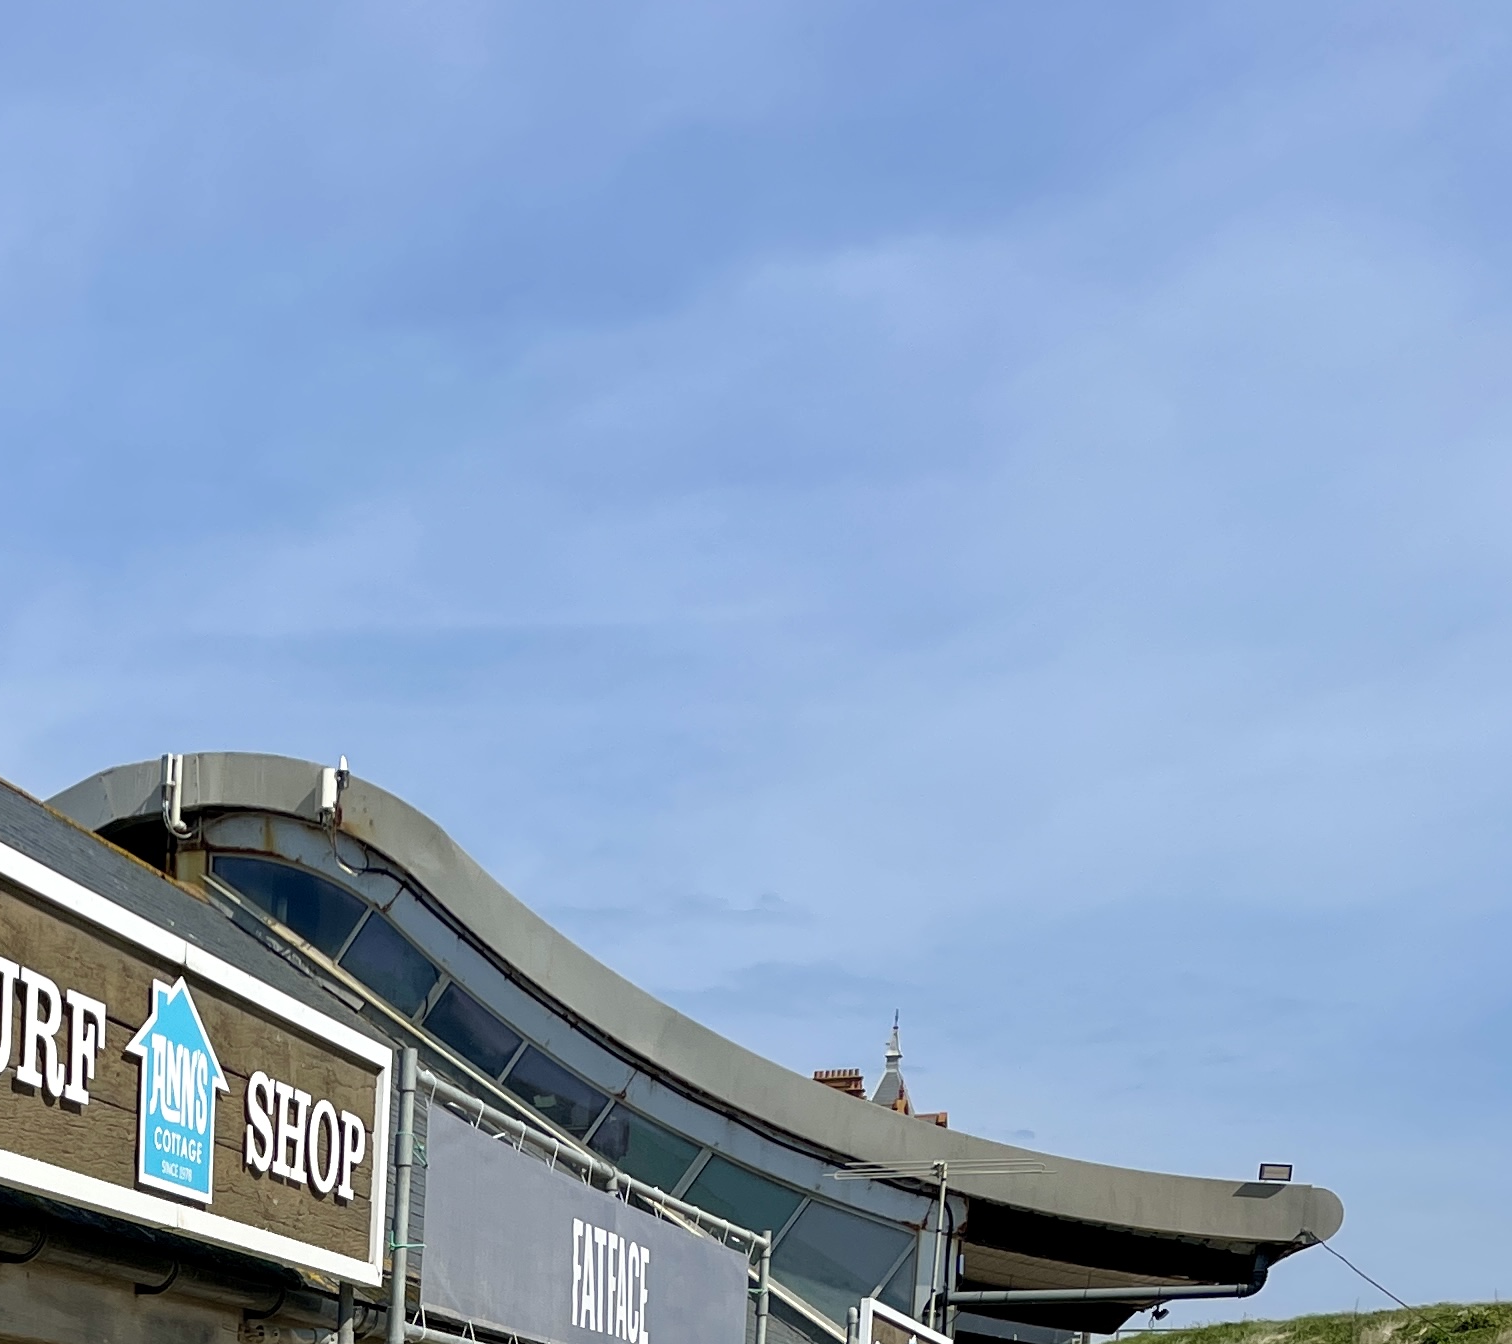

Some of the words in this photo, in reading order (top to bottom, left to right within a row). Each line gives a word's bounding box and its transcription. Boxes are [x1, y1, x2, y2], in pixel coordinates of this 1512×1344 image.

[154, 1127, 202, 1164] COTTAGE
[245, 1071, 366, 1201] SHOP
[161, 1159, 178, 1178] SINCE
[179, 1166, 193, 1183] 1978
